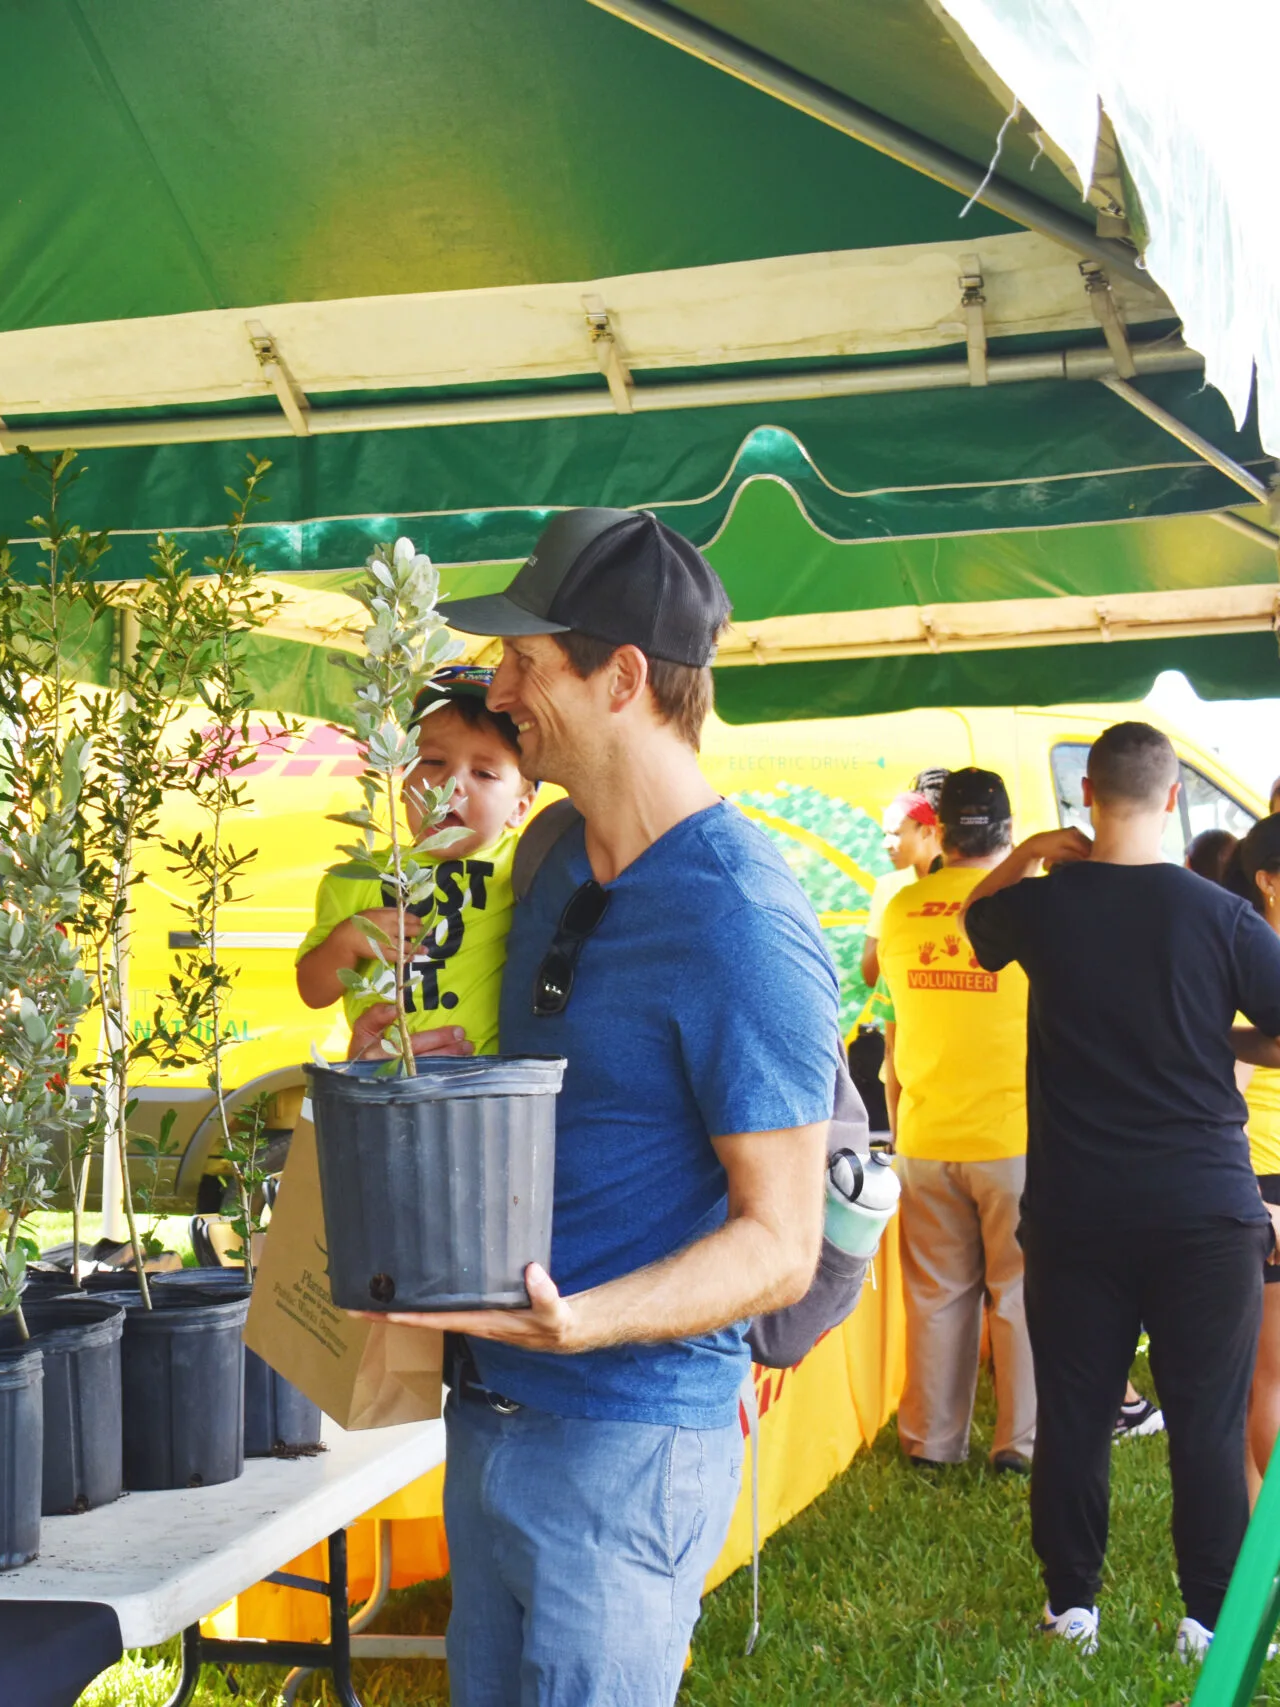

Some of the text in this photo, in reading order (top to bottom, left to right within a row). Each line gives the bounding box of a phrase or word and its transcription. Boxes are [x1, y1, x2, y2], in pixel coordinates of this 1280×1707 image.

[728, 756, 858, 770] ELECTRIC DRIVE
[908, 972, 994, 990] VOLUNTEER
